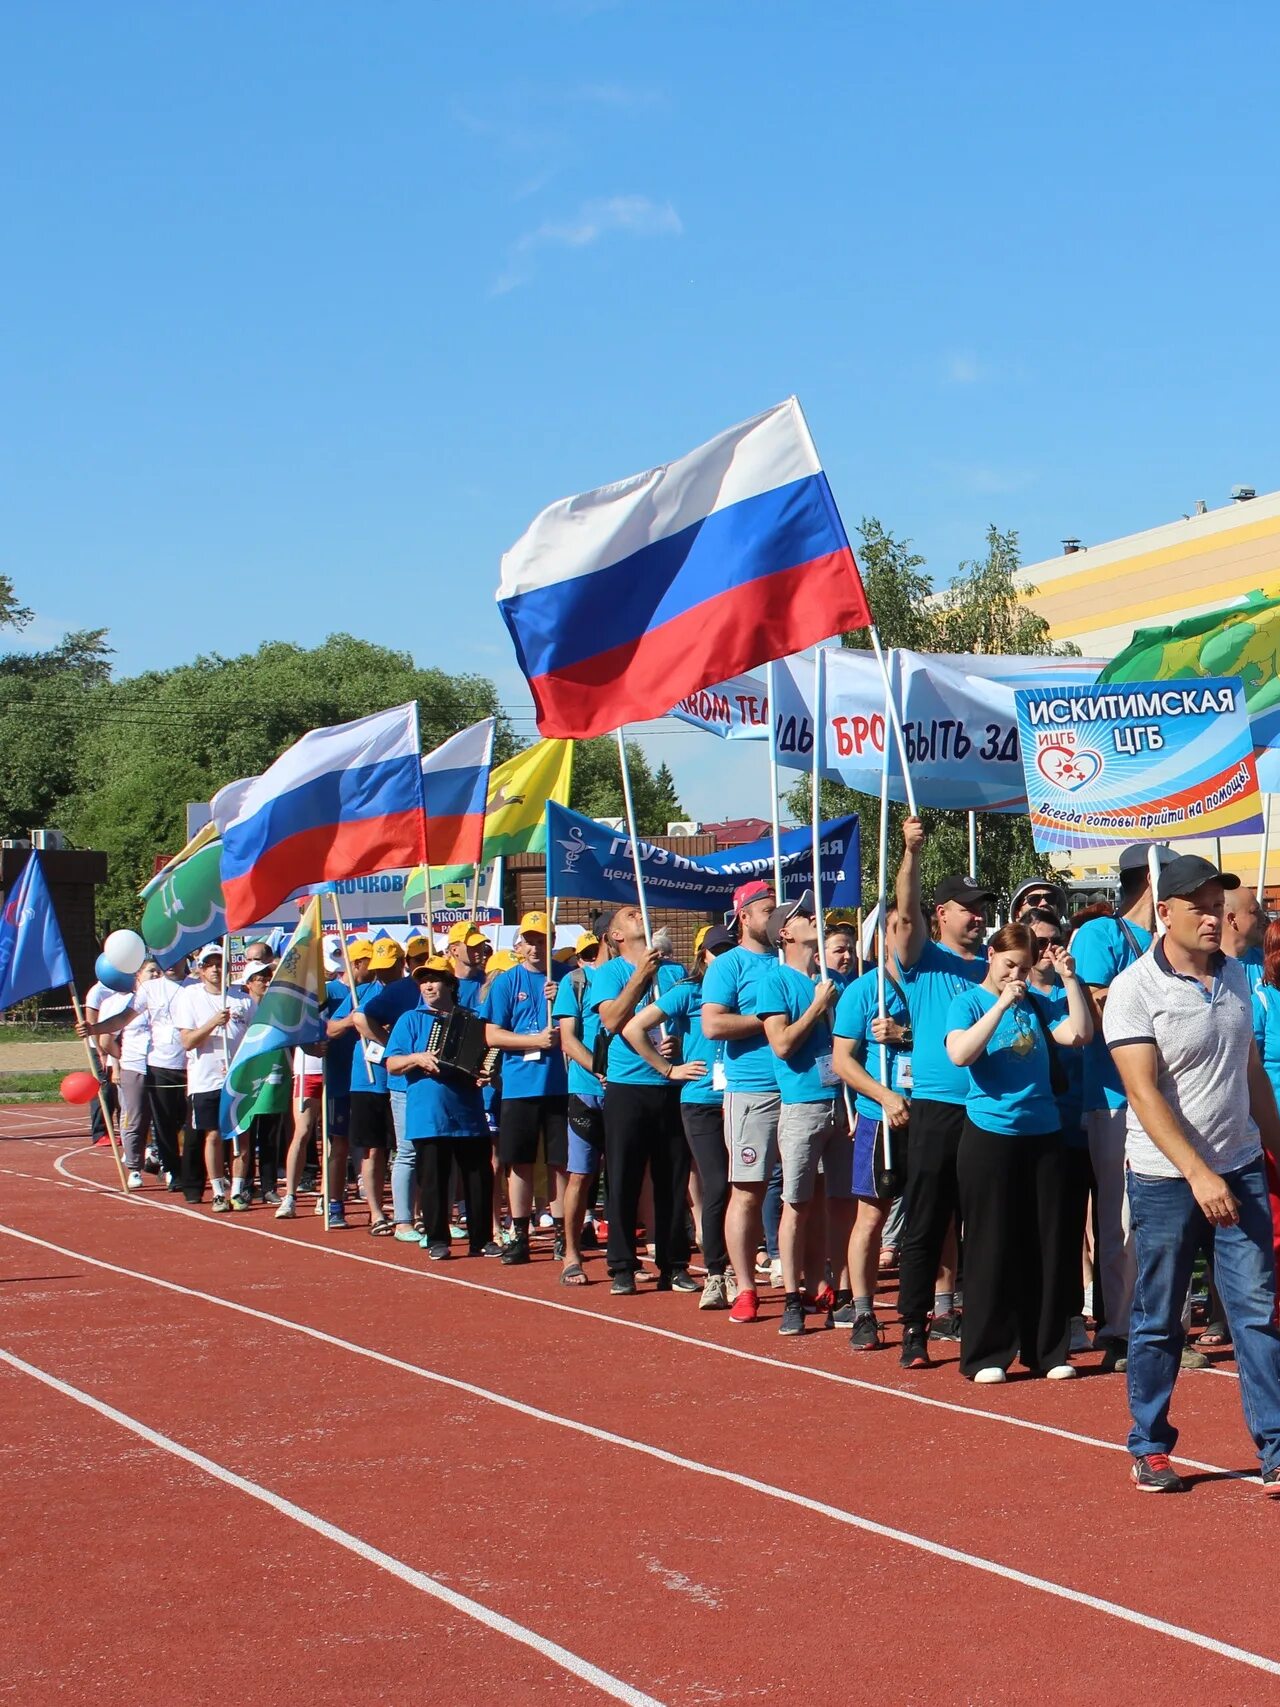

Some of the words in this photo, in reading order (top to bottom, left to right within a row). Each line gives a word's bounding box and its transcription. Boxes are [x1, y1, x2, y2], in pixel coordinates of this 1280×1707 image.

[1029, 688, 1235, 725] ИСКИТИМСКАЯ
[902, 719, 971, 763] БЫТЬ
[980, 724, 1018, 762] ЗД
[1038, 732, 1075, 748] ИЦГБ
[1113, 726, 1164, 755] ЦГБ
[1038, 802, 1082, 824] Всегда
[1086, 815, 1135, 828] готовы
[1140, 808, 1184, 832] прийти
[1188, 806, 1202, 819] на
[1206, 762, 1251, 811] помощь!
